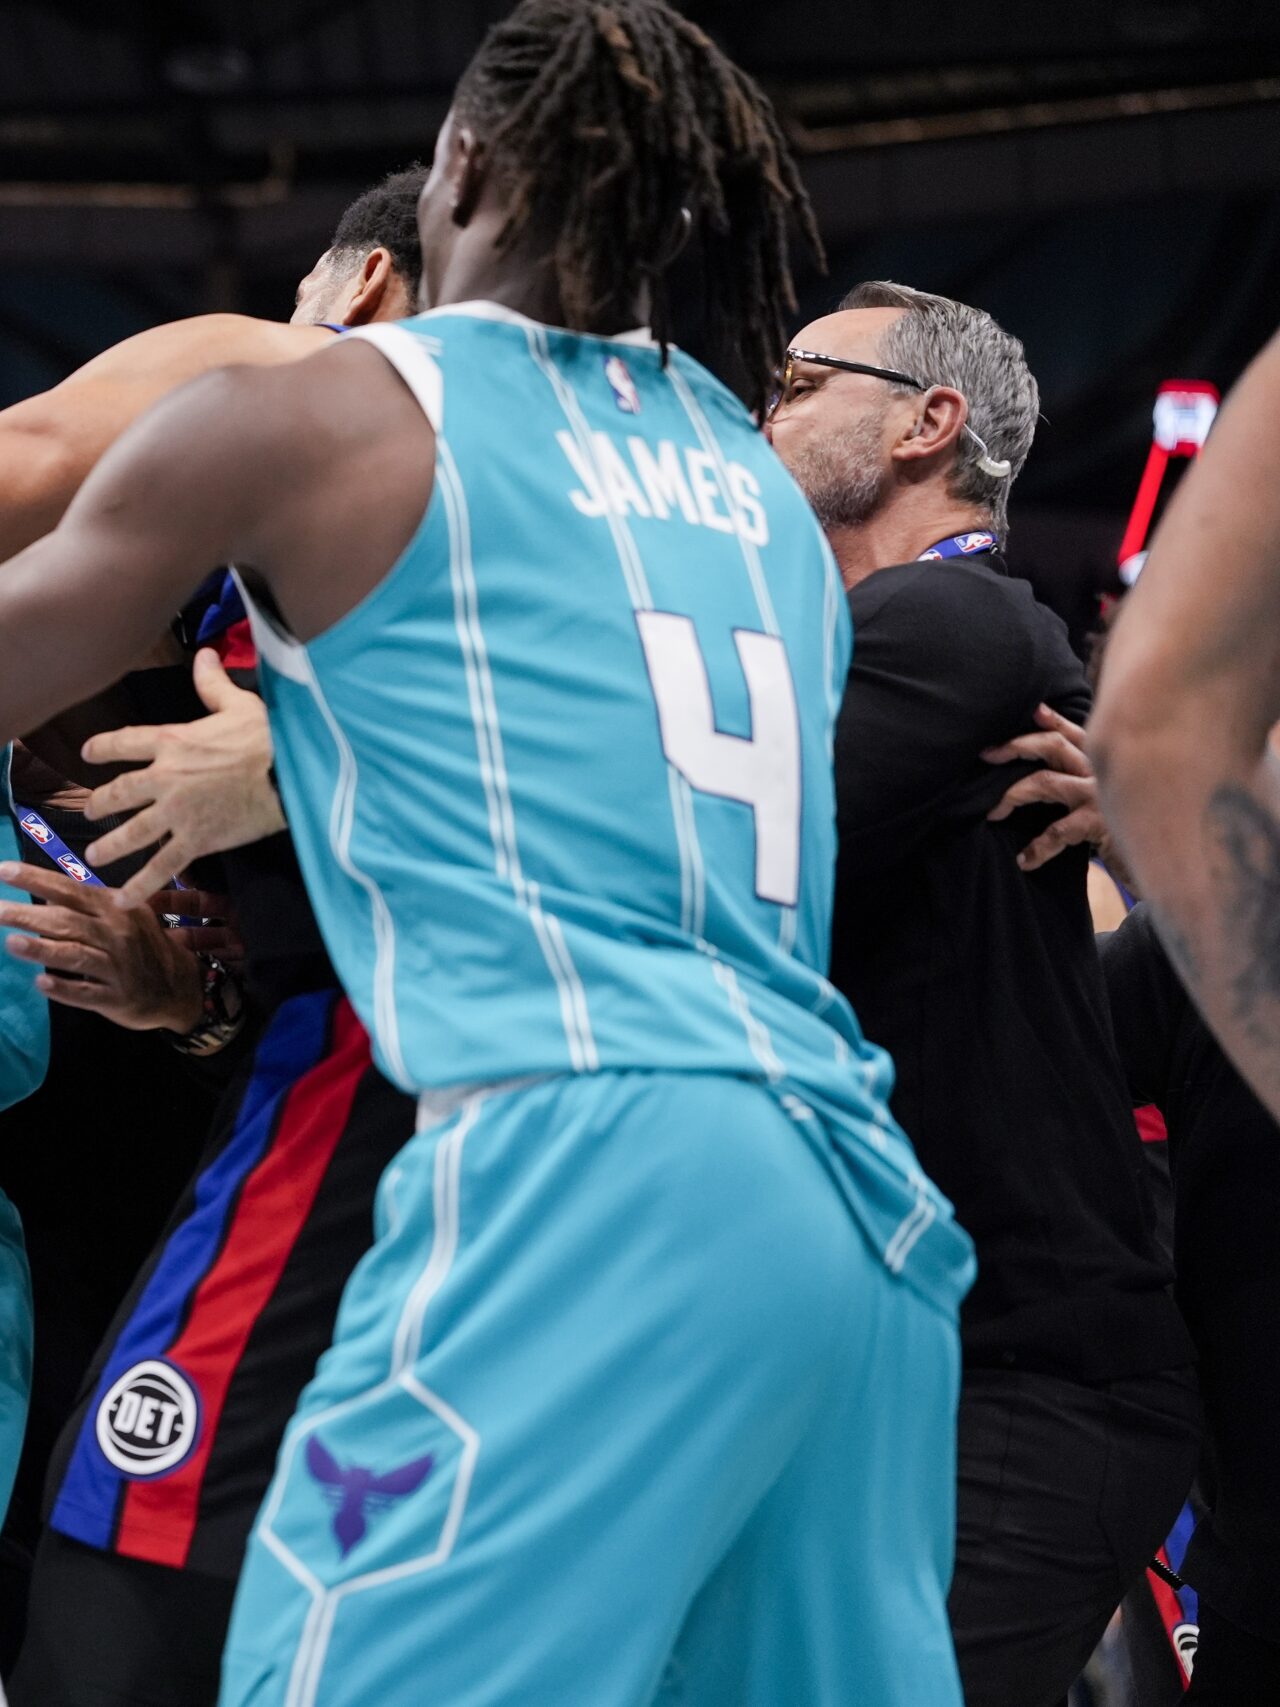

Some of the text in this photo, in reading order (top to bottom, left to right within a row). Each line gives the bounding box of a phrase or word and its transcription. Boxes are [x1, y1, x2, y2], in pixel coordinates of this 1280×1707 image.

[554, 430, 770, 547] JAMES
[634, 608, 804, 909] 4
[113, 1391, 180, 1446] DET
